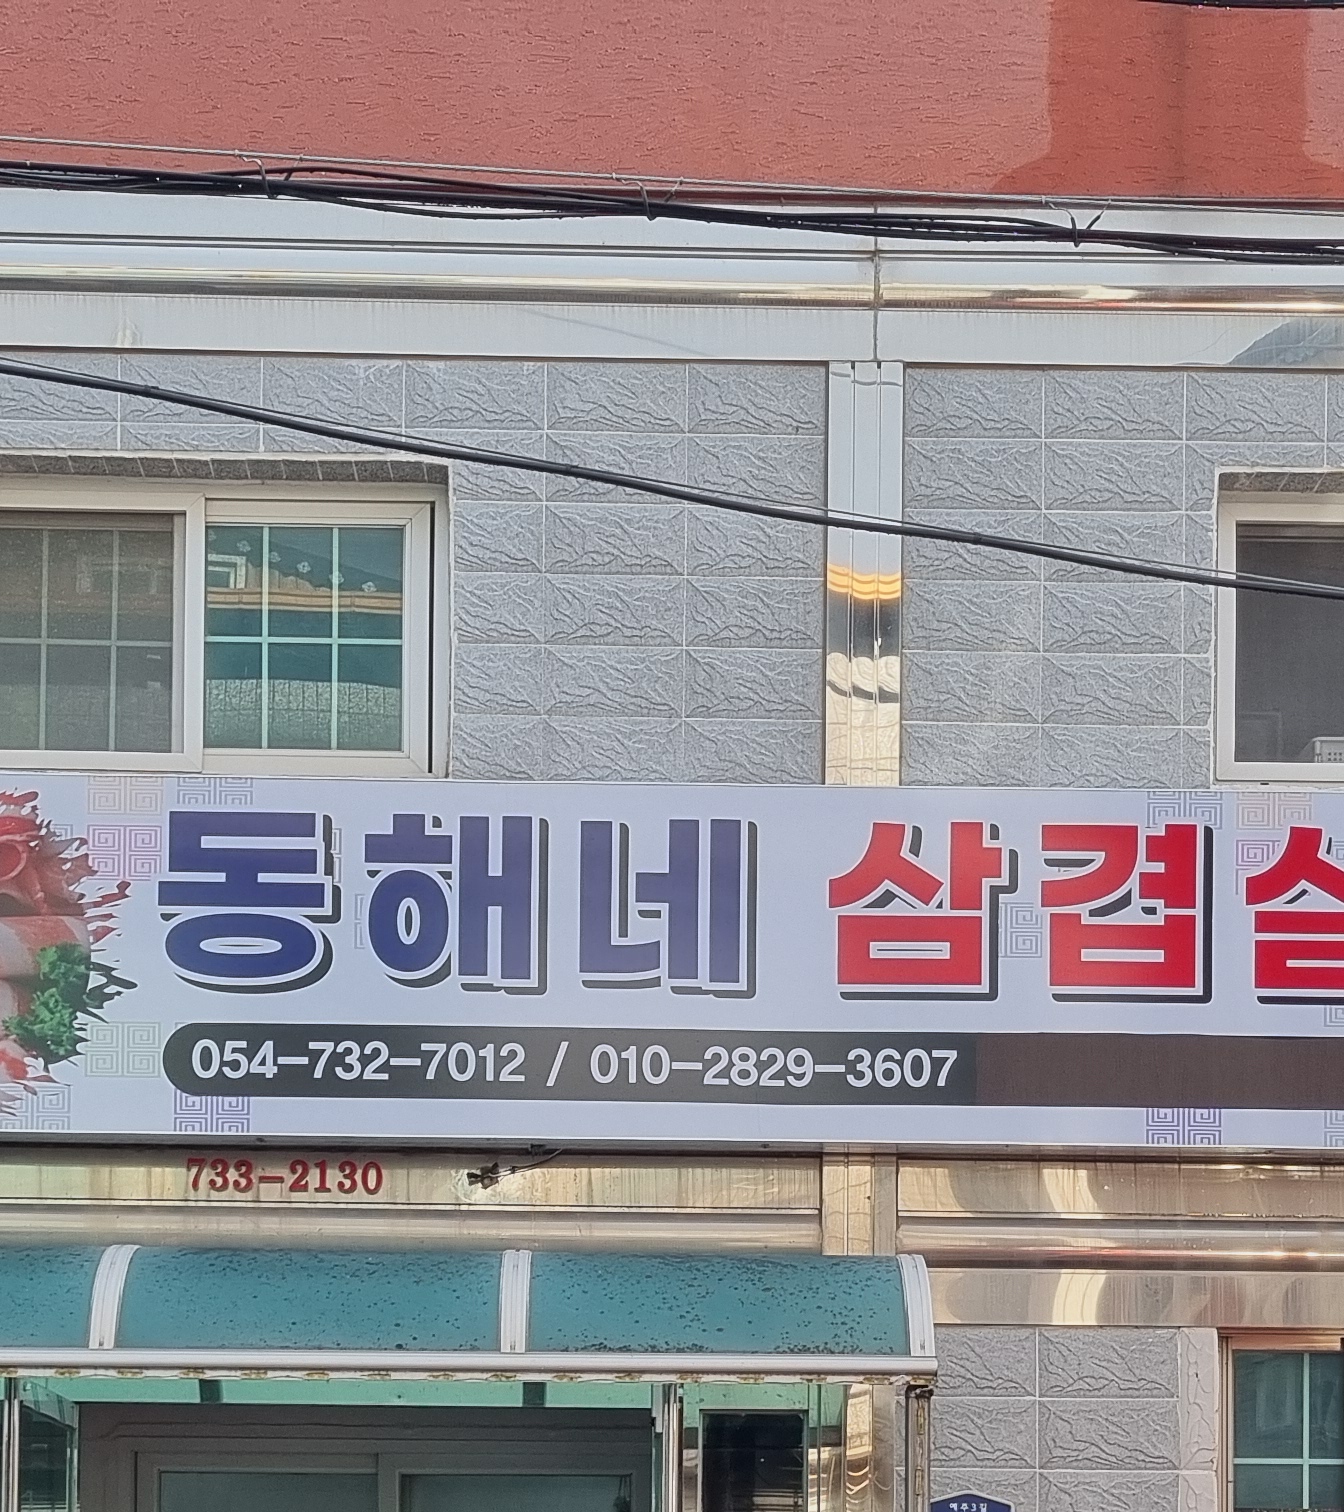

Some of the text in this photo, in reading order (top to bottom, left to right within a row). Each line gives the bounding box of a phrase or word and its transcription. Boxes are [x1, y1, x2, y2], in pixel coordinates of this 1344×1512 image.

[156, 810, 756, 998] 동해네
[192, 1038, 526, 1083] 054-732-7012
[590, 1043, 958, 1088] 010-2829-3607
[187, 1158, 383, 1196] 733-2130
